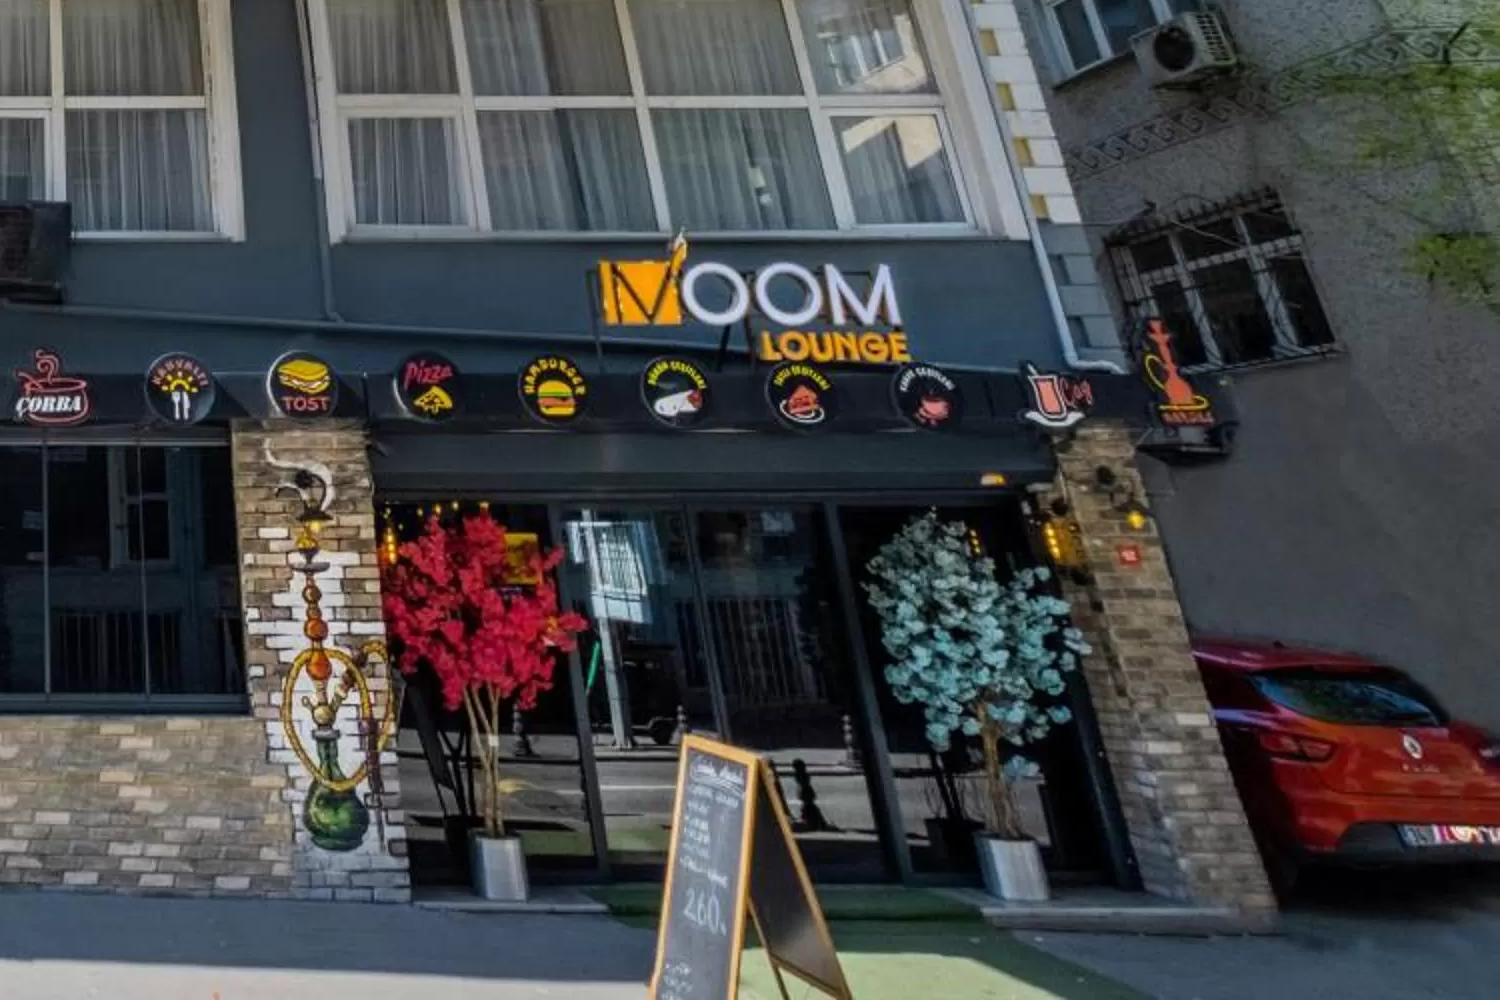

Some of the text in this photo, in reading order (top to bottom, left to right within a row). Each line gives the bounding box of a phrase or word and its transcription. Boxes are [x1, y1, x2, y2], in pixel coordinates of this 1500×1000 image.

[759, 329, 912, 363] LOUNGE
[524, 357, 587, 395] HAMBURGER
[14, 394, 83, 419] ÇORBA
[282, 396, 331, 412] TOST
